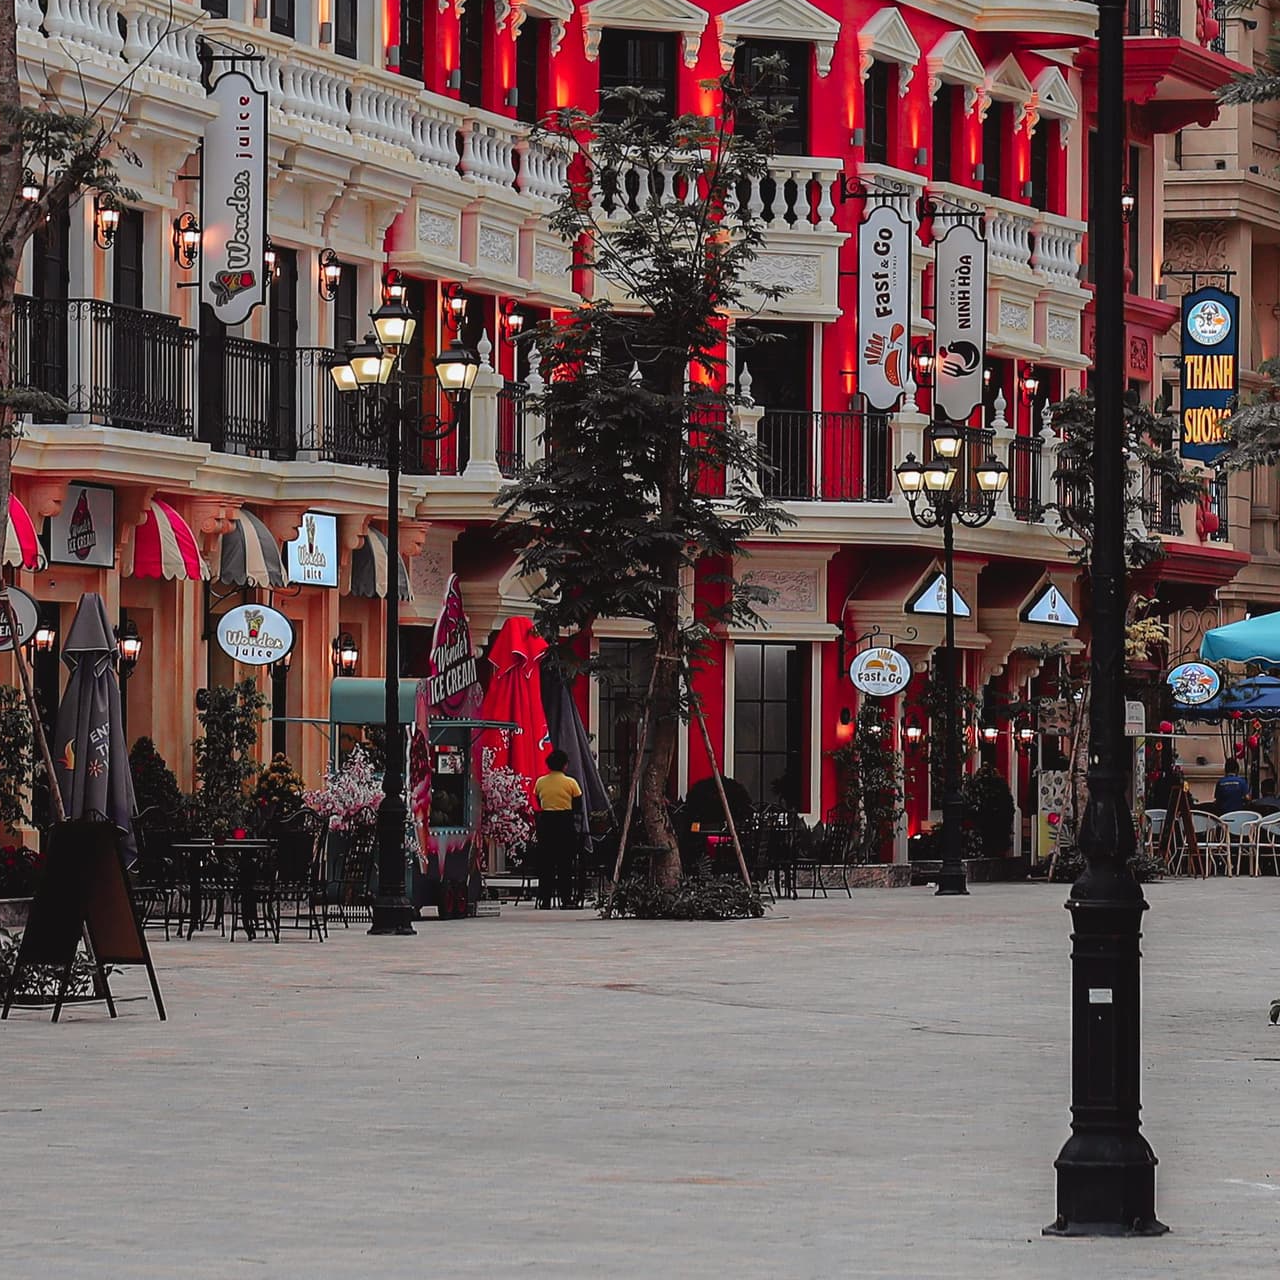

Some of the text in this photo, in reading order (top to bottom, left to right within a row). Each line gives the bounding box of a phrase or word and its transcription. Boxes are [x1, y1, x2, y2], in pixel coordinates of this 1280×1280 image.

[226, 95, 251, 271] Wonder juice
[872, 227, 894, 319] Fast & Go
[954, 254, 972, 330] NINH HÒA
[1184, 354, 1234, 390] THANH
[298, 545, 327, 568] Wonder
[303, 567, 323, 581] juice
[226, 630, 285, 649] Wonder
[235, 646, 274, 658] juice
[433, 632, 468, 672] Wonder
[430, 658, 478, 705] ICE CREAM
[857, 671, 881, 683] Fast
[888, 673, 903, 685] Go
